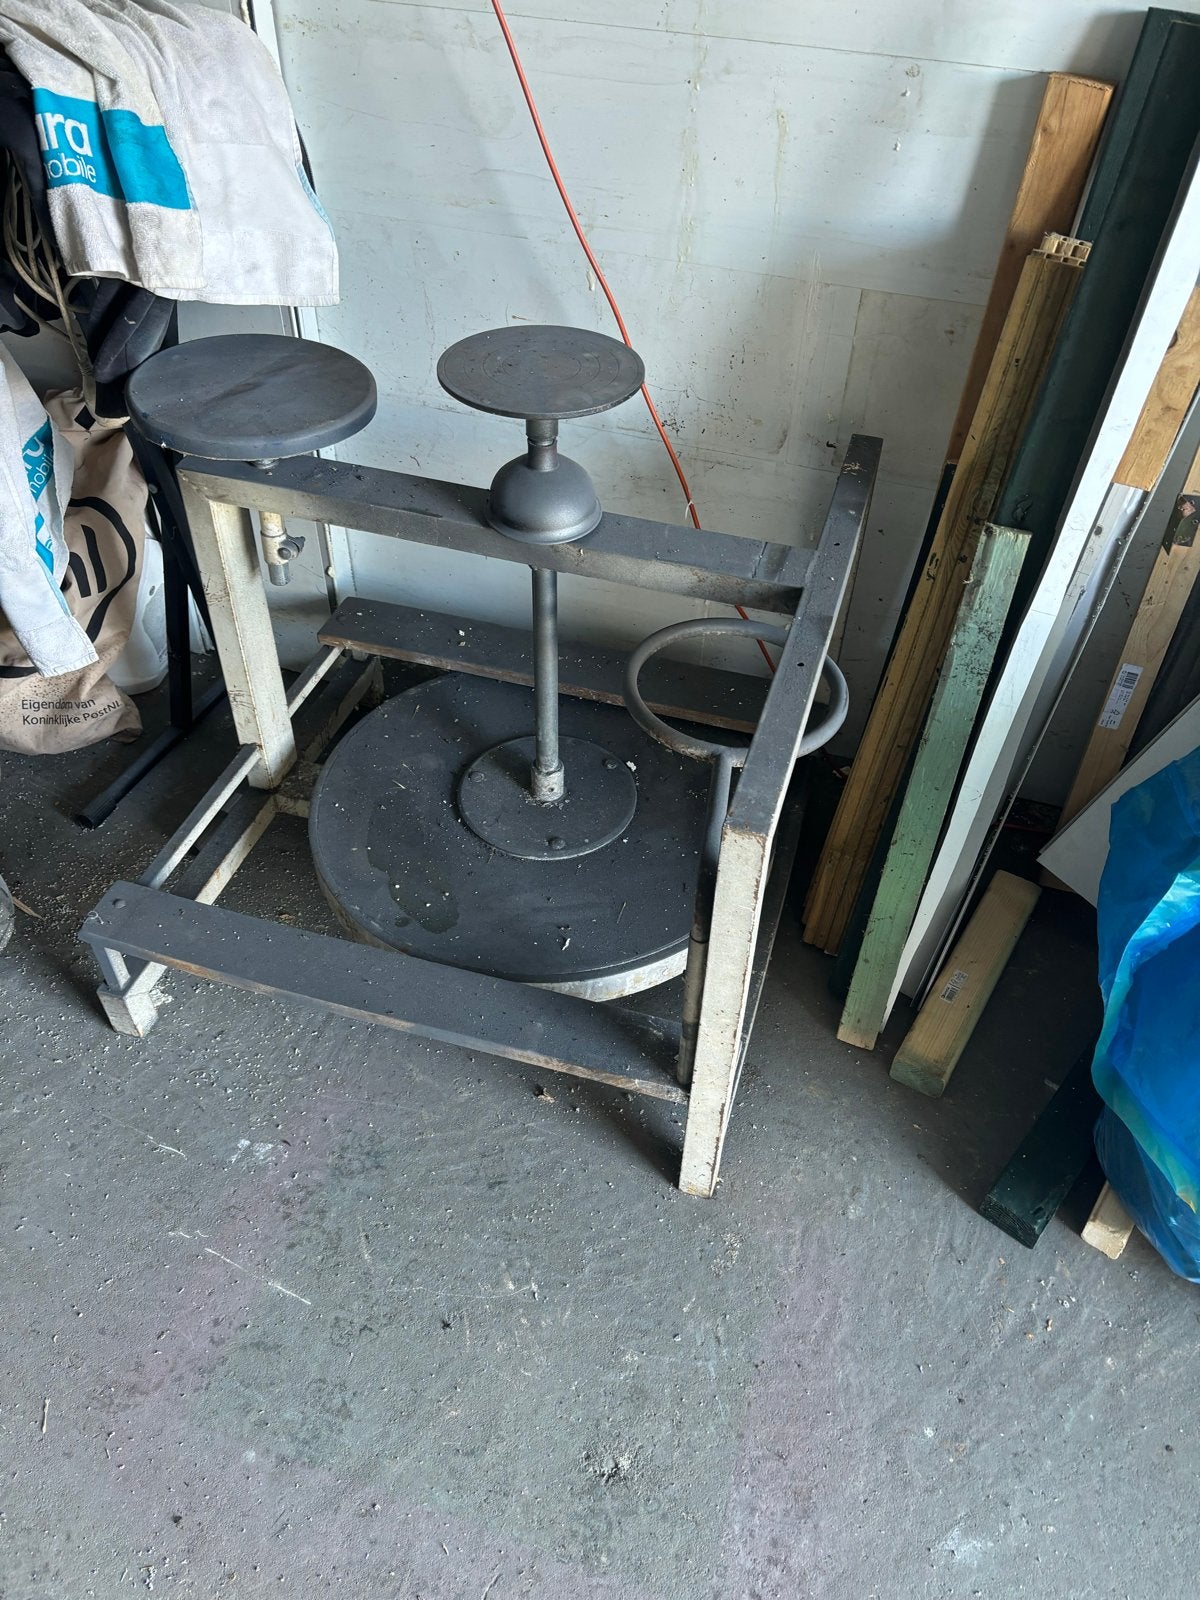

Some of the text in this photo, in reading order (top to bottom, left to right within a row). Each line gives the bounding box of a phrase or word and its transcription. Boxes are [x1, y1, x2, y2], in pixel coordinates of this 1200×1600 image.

[44, 153, 97, 183] obile
[21, 698, 96, 711] Eigendom van
[22, 700, 121, 727] Koninklijke PostNL
